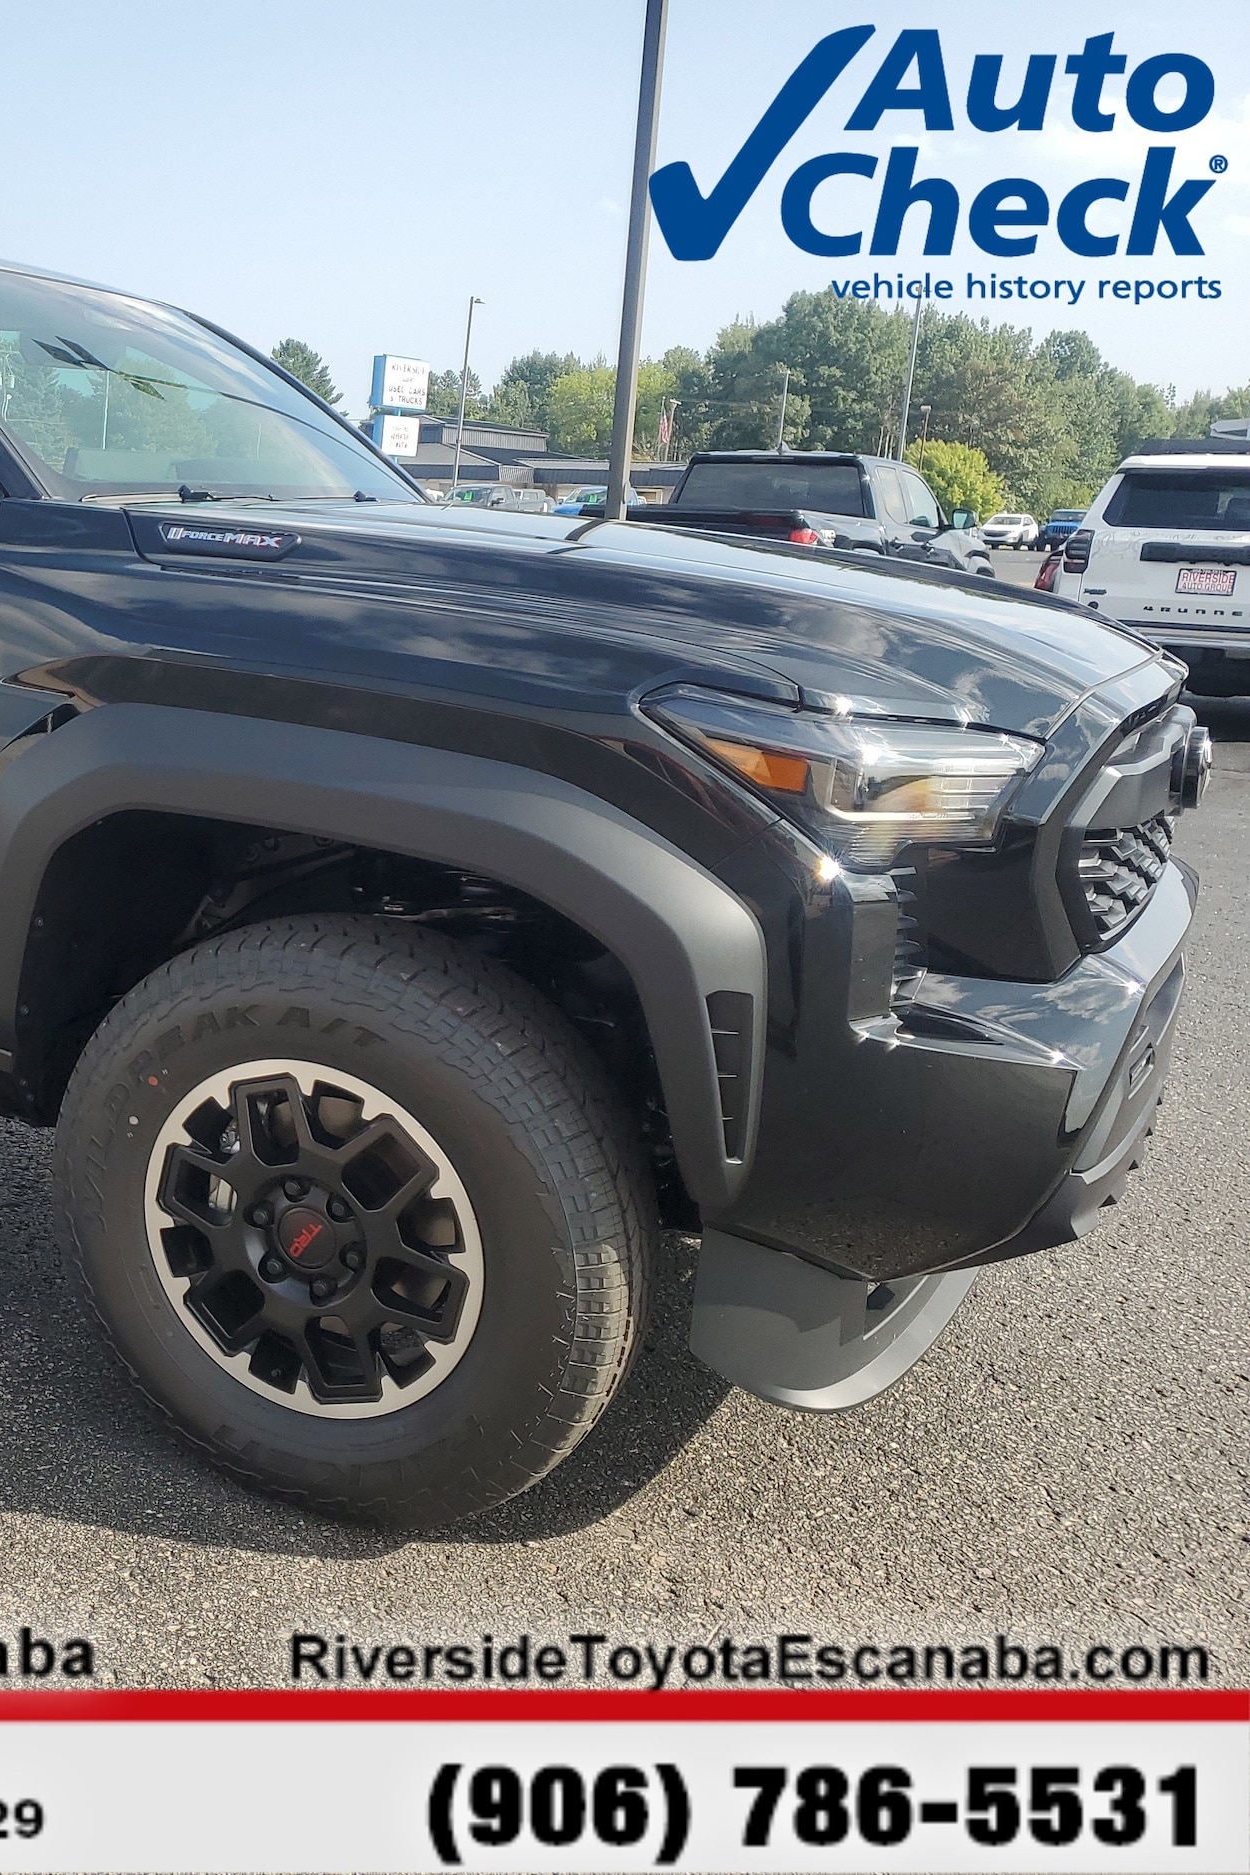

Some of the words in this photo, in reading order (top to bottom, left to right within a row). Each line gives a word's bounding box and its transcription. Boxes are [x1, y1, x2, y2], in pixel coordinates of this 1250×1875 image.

[398, 395, 423, 406] TRUCKS
[1181, 571, 1236, 585] RIVERSIDE
[1181, 582, 1203, 591] AUTO
[1204, 582, 1234, 593] GROUP
[1143, 605, 1250, 617] 4RUNNE
[289, 1223, 323, 1258] TRD
